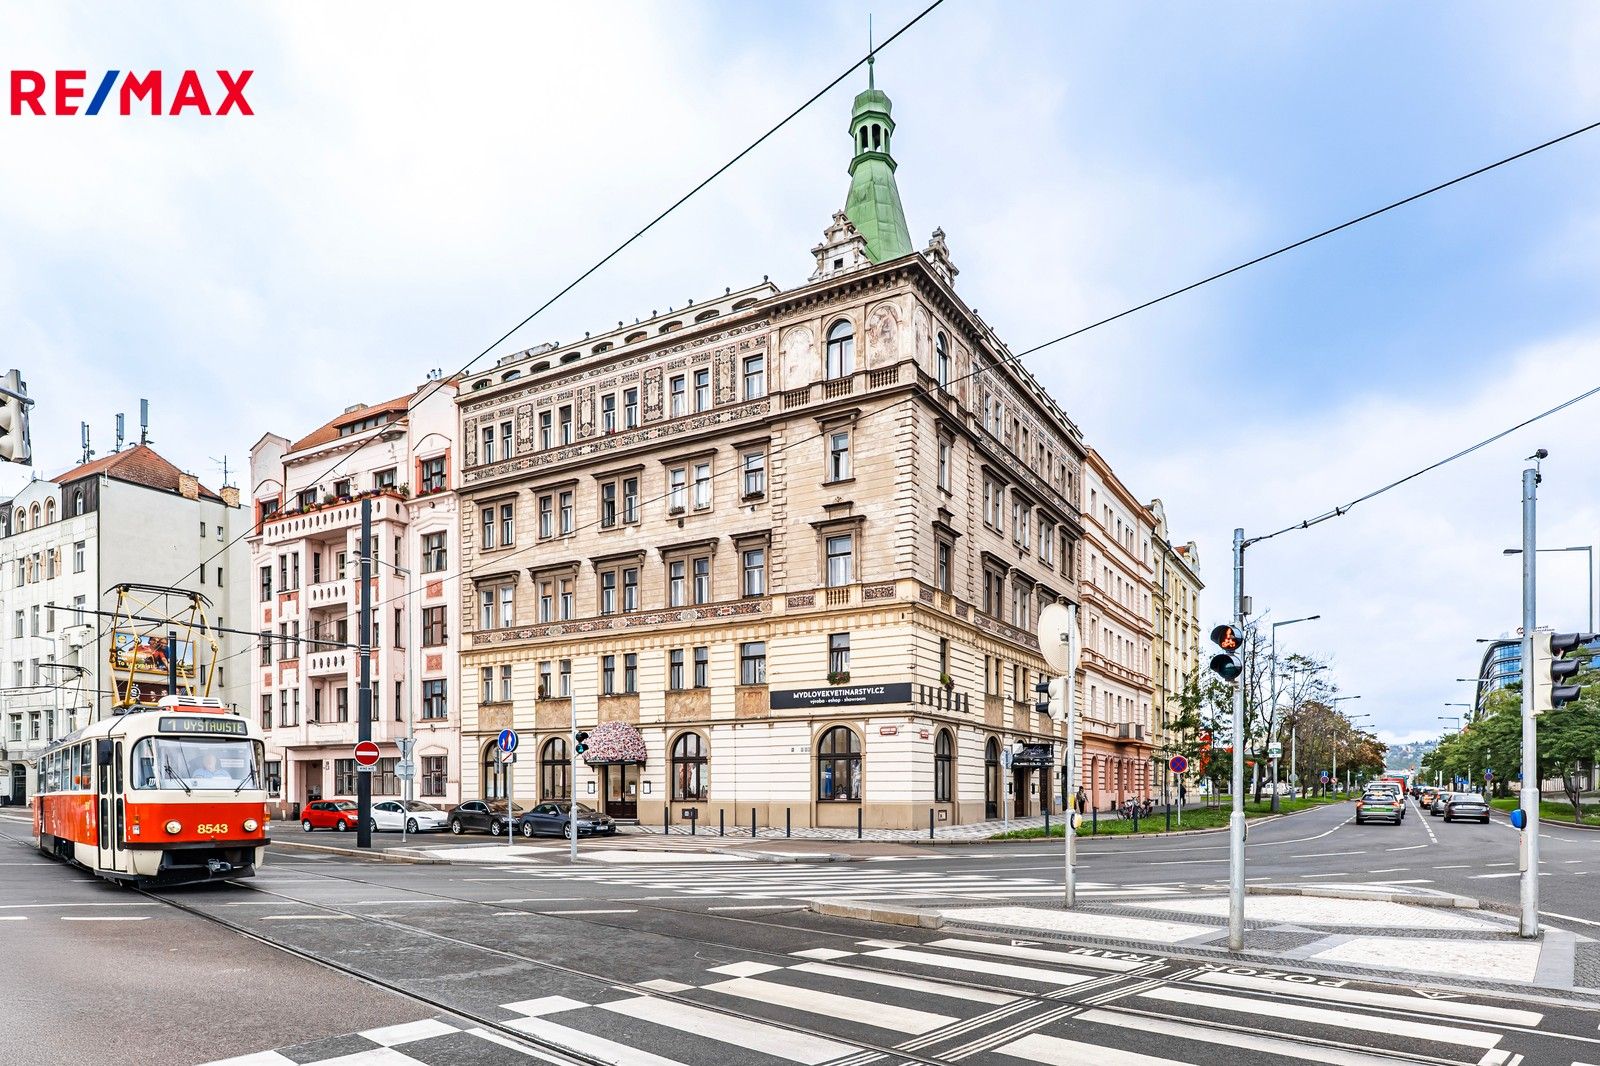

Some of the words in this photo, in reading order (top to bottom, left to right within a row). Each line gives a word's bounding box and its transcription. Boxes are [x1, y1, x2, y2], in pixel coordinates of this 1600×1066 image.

[168, 721, 176, 731] 1
[197, 823, 229, 834] 8543
[1198, 963, 1349, 987] POZOR
